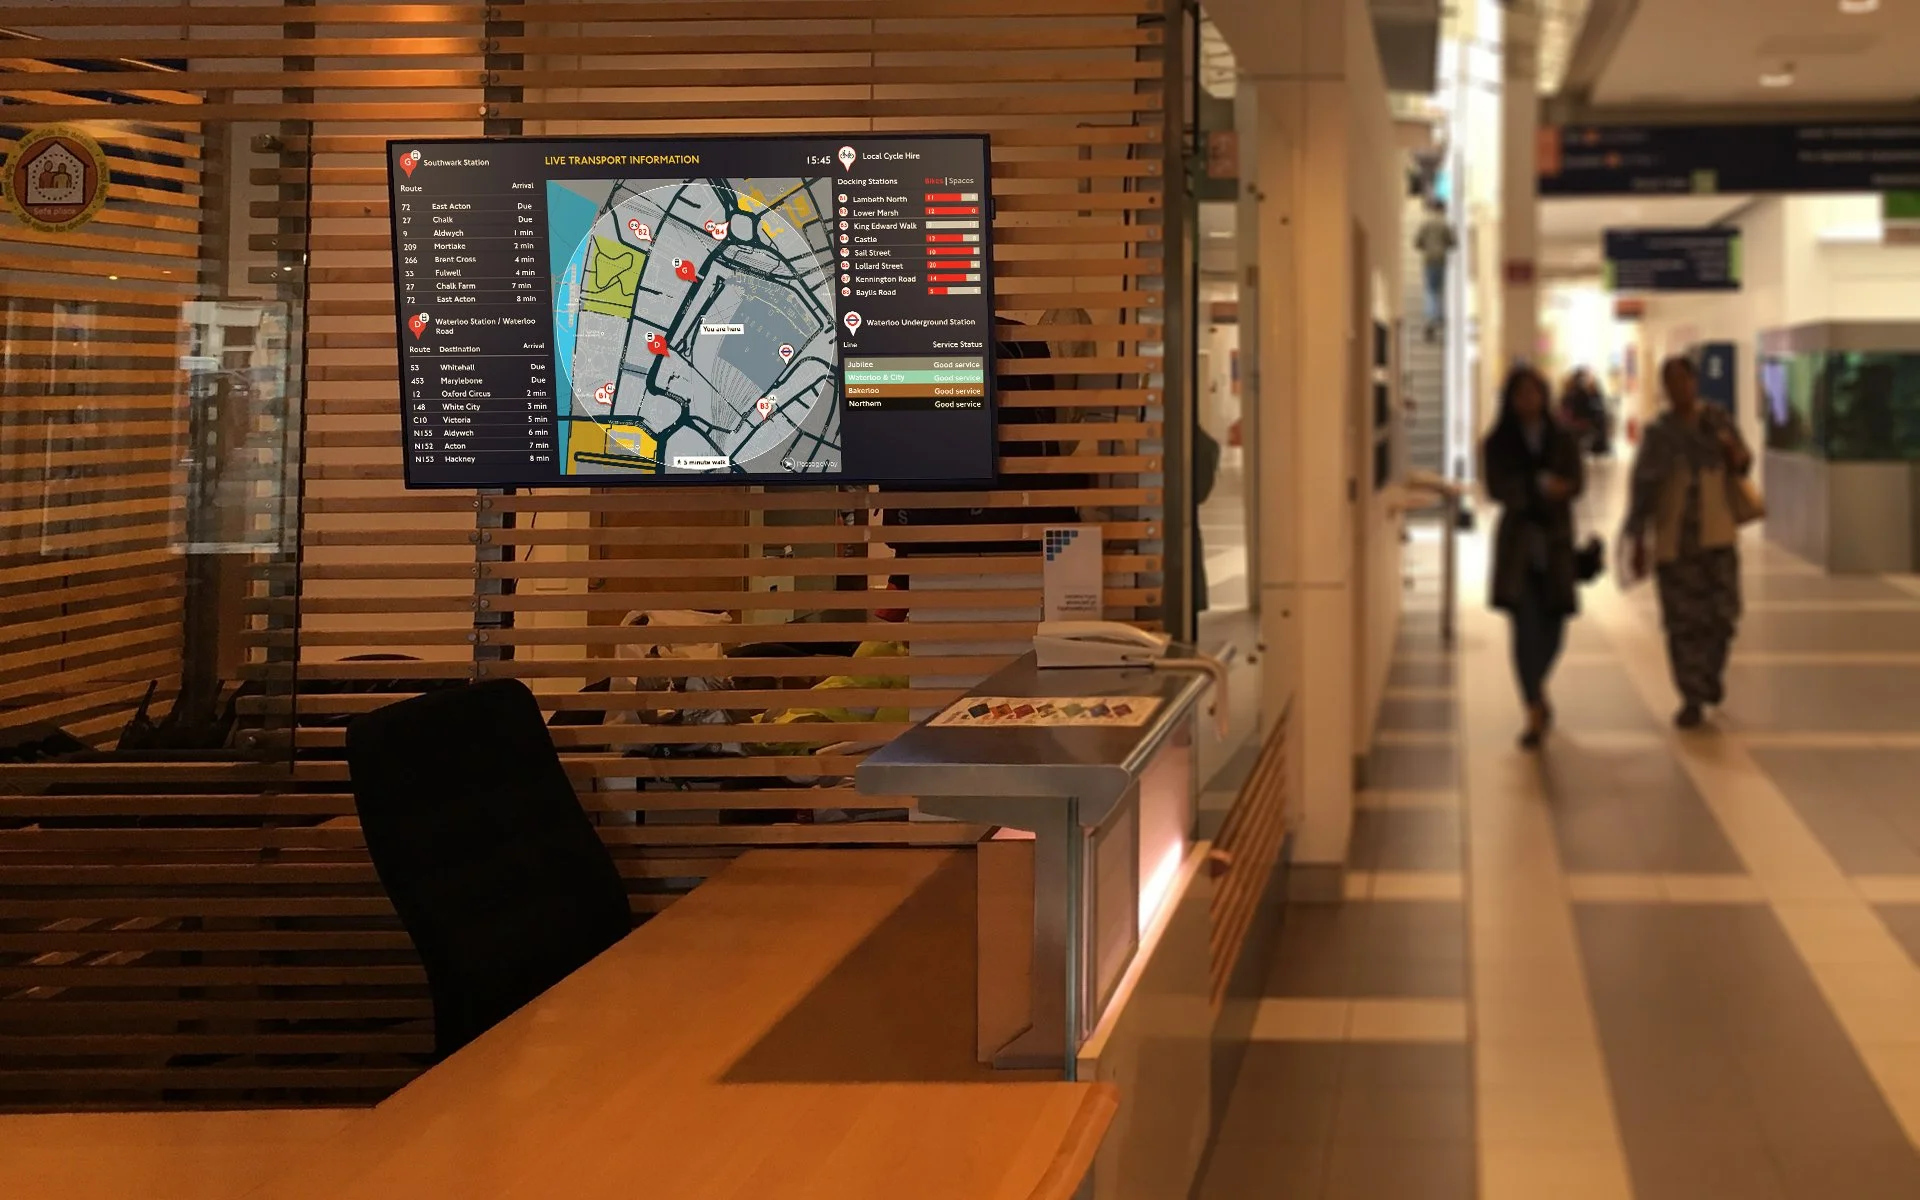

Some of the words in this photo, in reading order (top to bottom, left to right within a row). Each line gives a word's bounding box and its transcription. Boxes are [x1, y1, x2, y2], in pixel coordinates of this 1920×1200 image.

[545, 155, 566, 165] LIVE
[568, 155, 627, 165] TRANSPORT
[630, 154, 700, 164] INFORMATION
[806, 155, 831, 165] 15:45
[883, 152, 904, 161] Cycle
[404, 158, 412, 168] G
[423, 158, 462, 168] Southwark
[462, 158, 490, 167] Station
[837, 178, 867, 186] Docking
[948, 177, 974, 185] Spaces
[400, 184, 422, 192] Route
[512, 181, 534, 190] Arrival
[401, 202, 410, 211] 72
[432, 202, 448, 210] East
[448, 202, 472, 210] Acton
[517, 202, 532, 210] Due
[53, 208, 76, 216] place
[402, 216, 412, 224] 27
[432, 215, 454, 224] Chalk
[518, 215, 533, 224] Due
[854, 223, 870, 231] King
[402, 230, 408, 238] 9
[433, 228, 464, 238] Aldwych
[519, 228, 534, 237] min
[403, 242, 418, 251] 209
[434, 242, 466, 250] Mortlake
[514, 242, 520, 250] 2
[521, 242, 534, 250] min
[404, 256, 418, 264] 266
[434, 256, 454, 264] Brent
[455, 256, 477, 264] Cross
[514, 256, 520, 264] 4
[522, 256, 536, 264] min
[404, 270, 414, 278] 33
[435, 268, 462, 277] Fulwell
[515, 269, 521, 277] 4
[522, 269, 536, 277] min
[855, 275, 897, 284] Kennington
[406, 282, 415, 291] 27
[436, 282, 456, 290] Chalk
[458, 282, 476, 290] Farm
[518, 282, 532, 290] min
[856, 289, 877, 298] Baylis
[406, 296, 416, 304] 72
[436, 295, 452, 304] East
[454, 295, 476, 304] Acton
[516, 295, 522, 303] 8
[522, 295, 536, 303] min
[901, 319, 948, 328] Underground
[440, 377, 483, 386] Marylebone
[890, 374, 905, 382] City
[466, 403, 481, 412] City
[444, 456, 476, 464] Hackney
